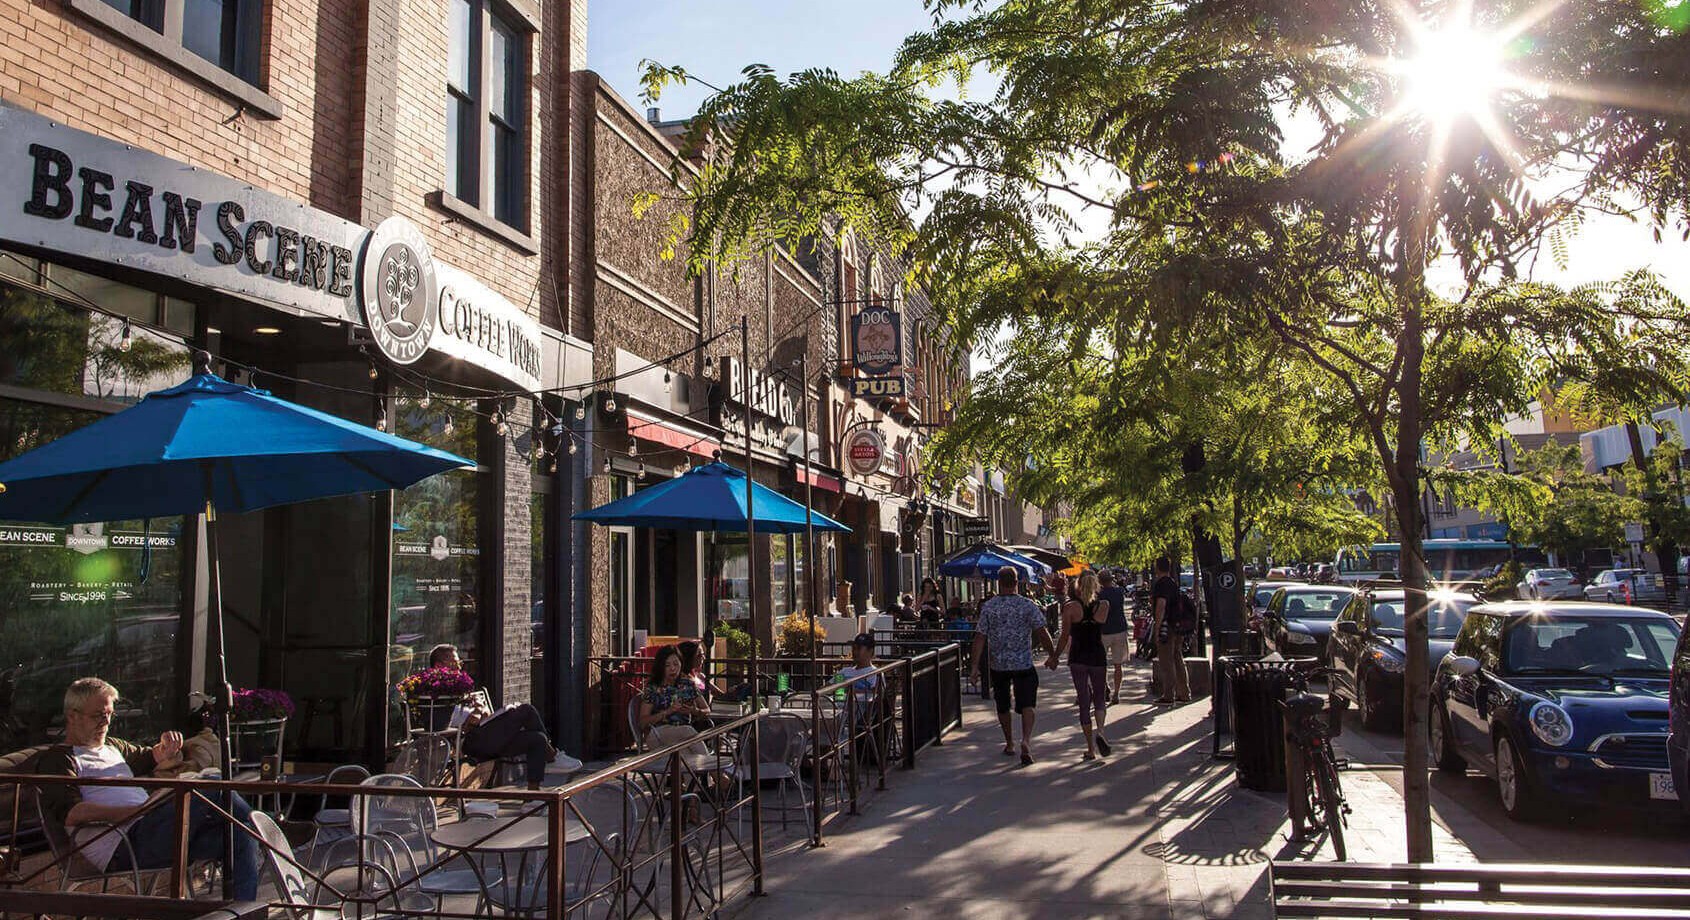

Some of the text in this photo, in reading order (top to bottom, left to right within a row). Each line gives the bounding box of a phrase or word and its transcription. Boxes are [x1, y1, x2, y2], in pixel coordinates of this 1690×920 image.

[24, 143, 352, 297] BEAN SCENE
[861, 311, 891, 325] DOC
[369, 299, 433, 358] DOWNTOWN
[439, 286, 541, 382] COFFEE WORKS
[855, 380, 901, 395] PUB
[23, 532, 56, 542] SCENE
[67, 537, 107, 546] DOWNTOWN
[112, 535, 176, 546] COFFEE WORKS
[1223, 574, 1233, 587] P
[60, 591, 106, 602] SINCE 1996
